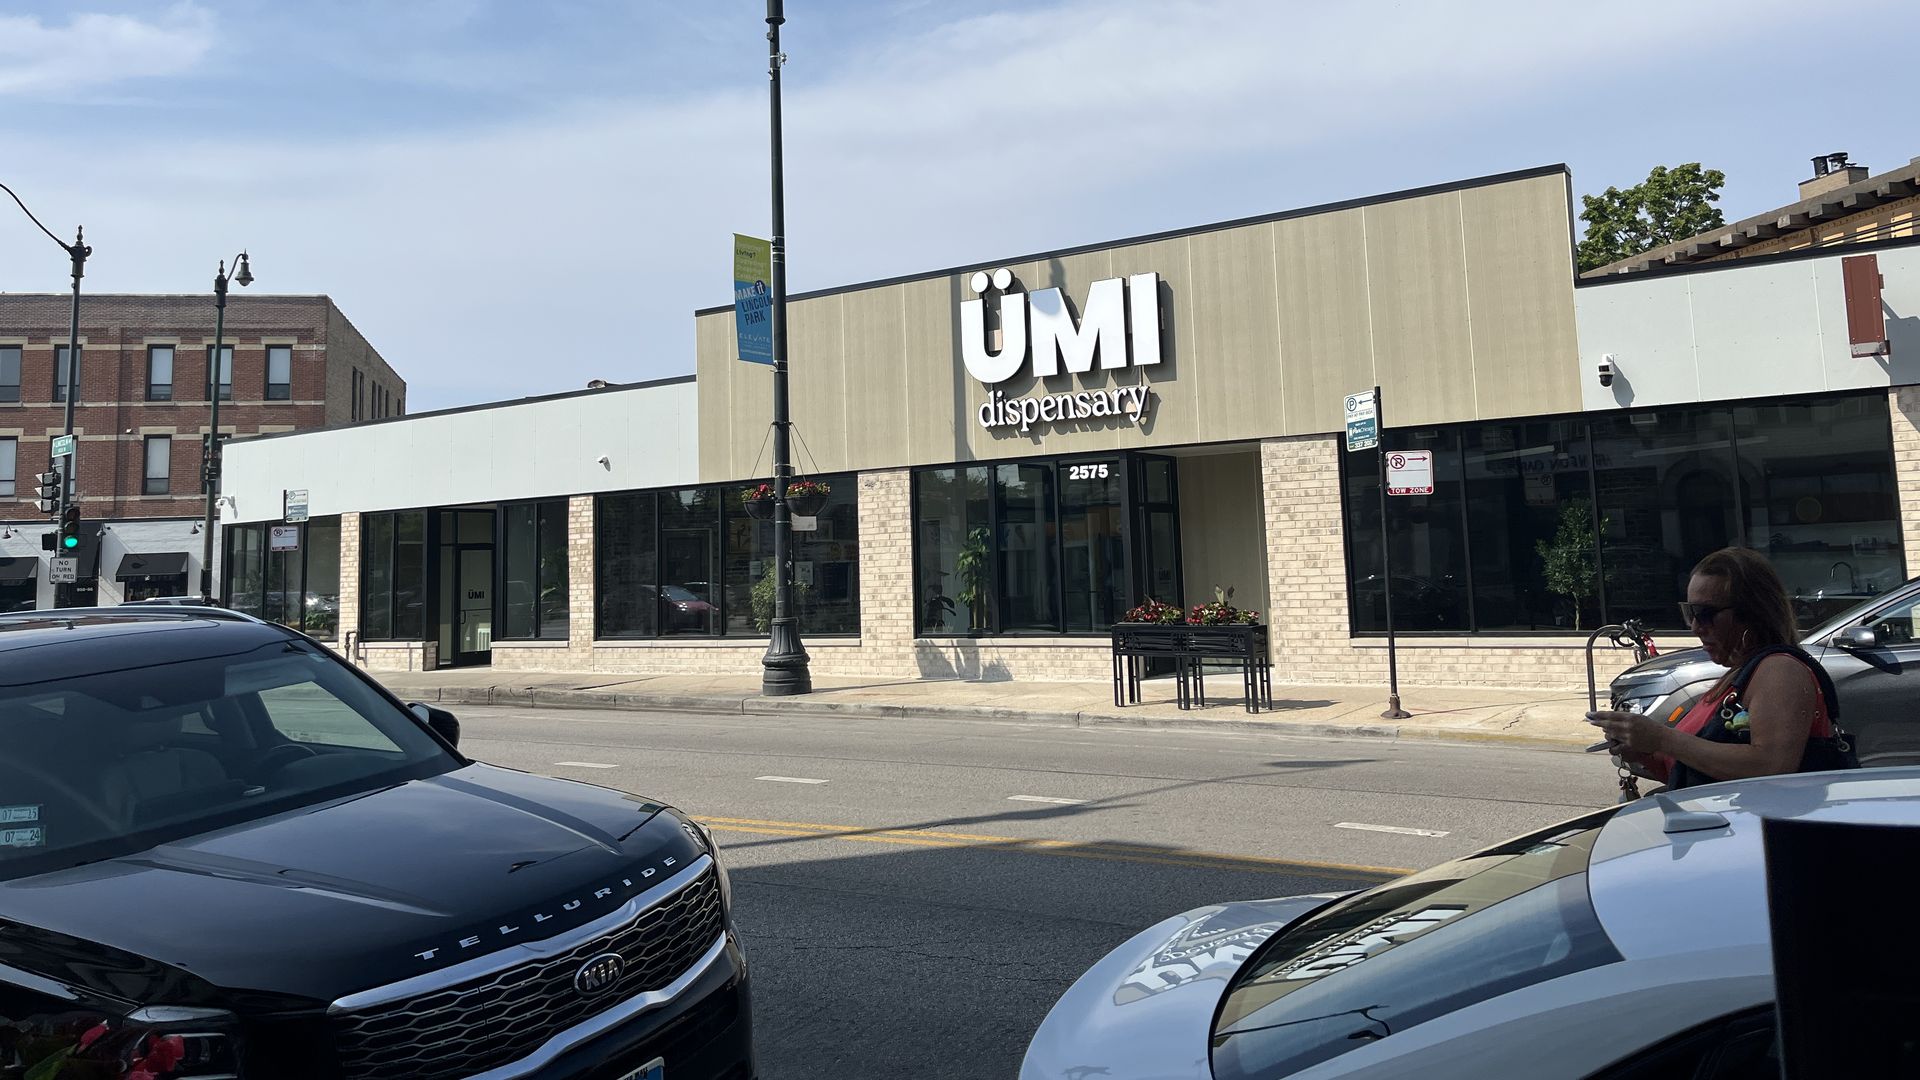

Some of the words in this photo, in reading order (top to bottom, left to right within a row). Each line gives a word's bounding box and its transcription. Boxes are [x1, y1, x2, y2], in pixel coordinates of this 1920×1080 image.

[735, 286, 756, 301] MAKE
[744, 311, 765, 325] PARK
[960, 268, 1161, 384] ÜMI
[978, 384, 1150, 432] dispensary
[1069, 464, 1109, 480] 2575
[2, 809, 13, 821] 07
[5, 831, 15, 843] 07
[30, 829, 39, 840] 24
[414, 856, 677, 960] TELLURIDE
[583, 958, 621, 991] KIA
